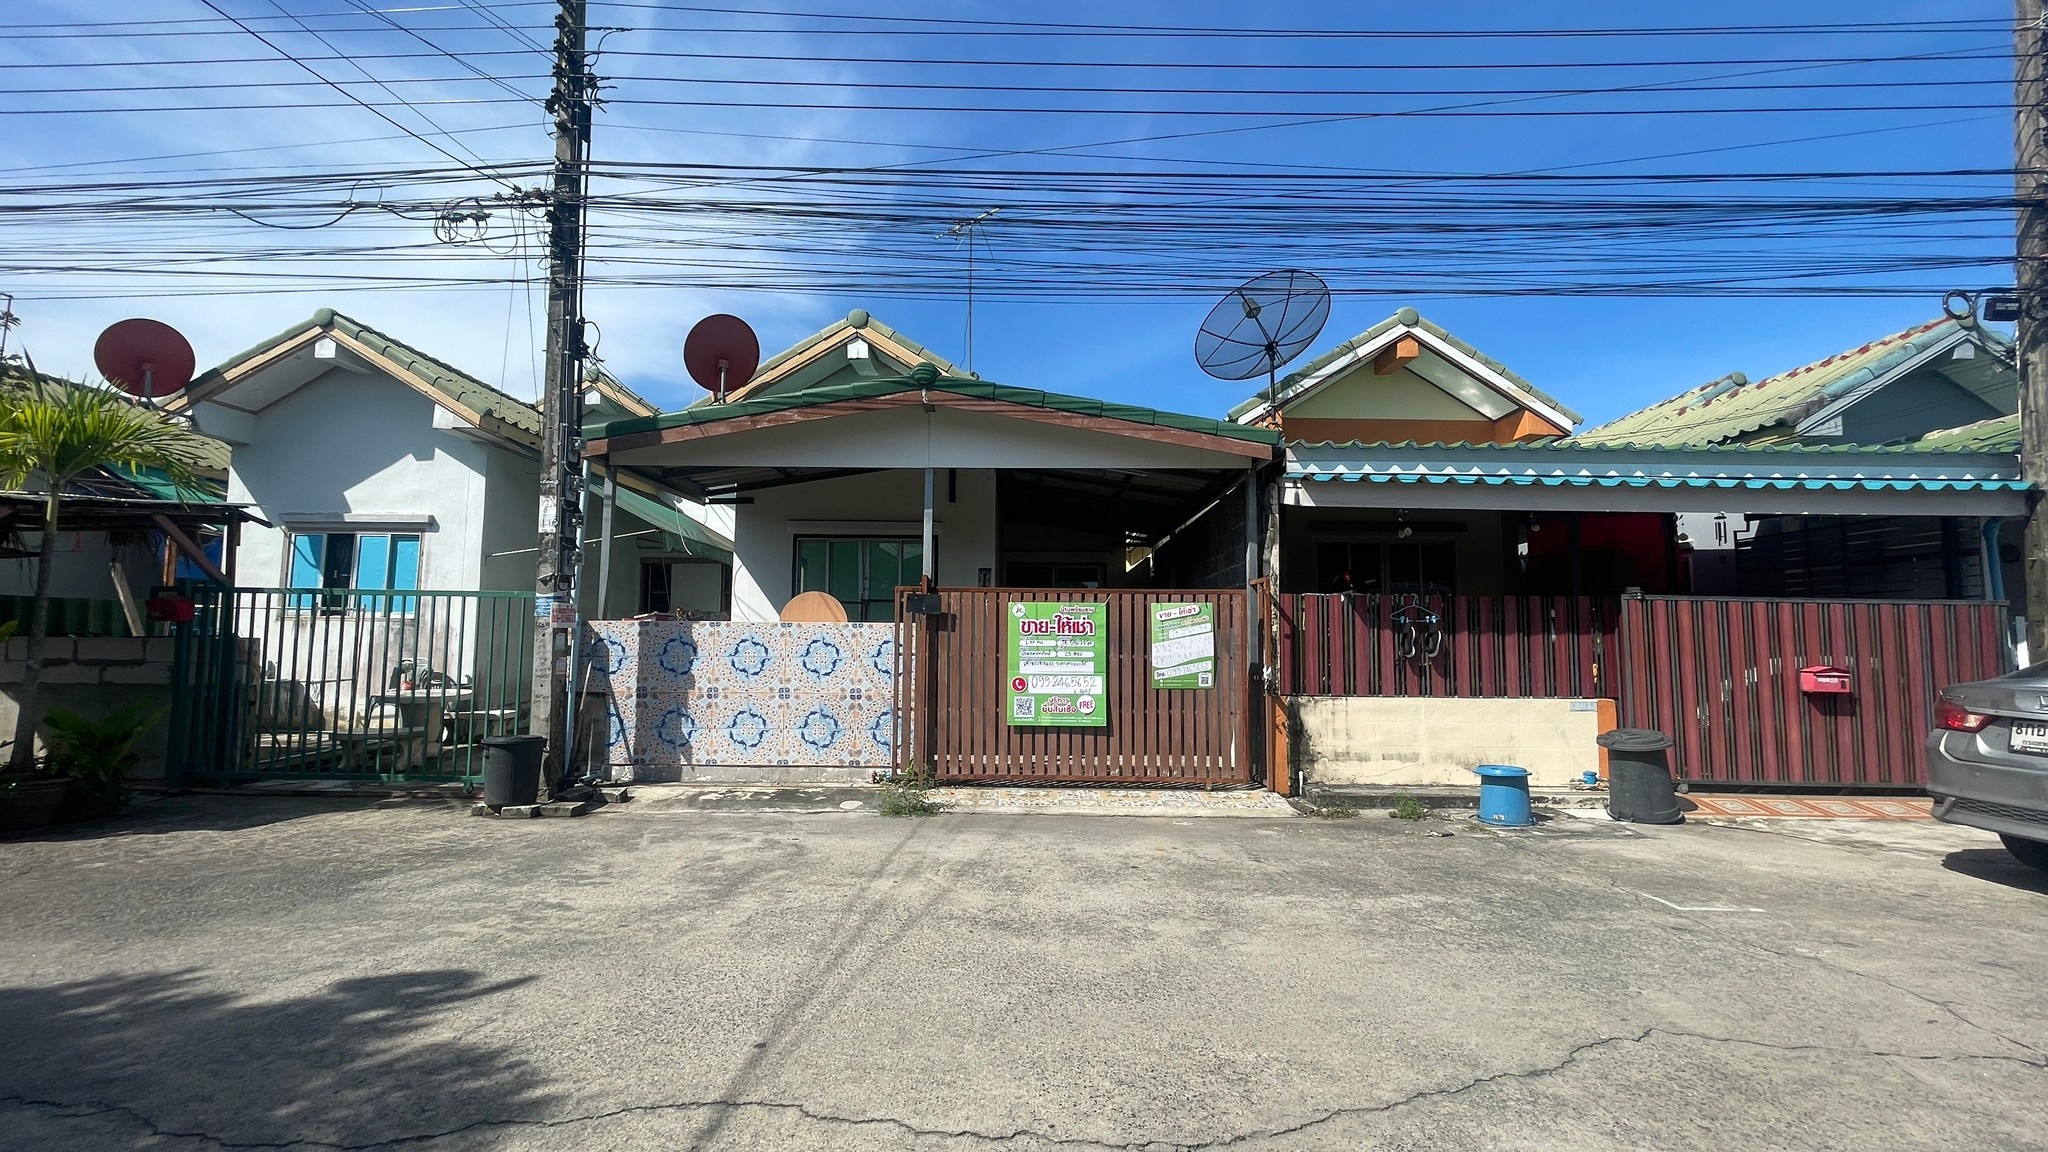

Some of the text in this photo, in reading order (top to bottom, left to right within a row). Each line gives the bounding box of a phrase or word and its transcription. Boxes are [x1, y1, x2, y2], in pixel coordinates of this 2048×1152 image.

[1020, 614, 1094, 634] ขาย-ให้เช่า
[1079, 700, 1094, 709] FREE
